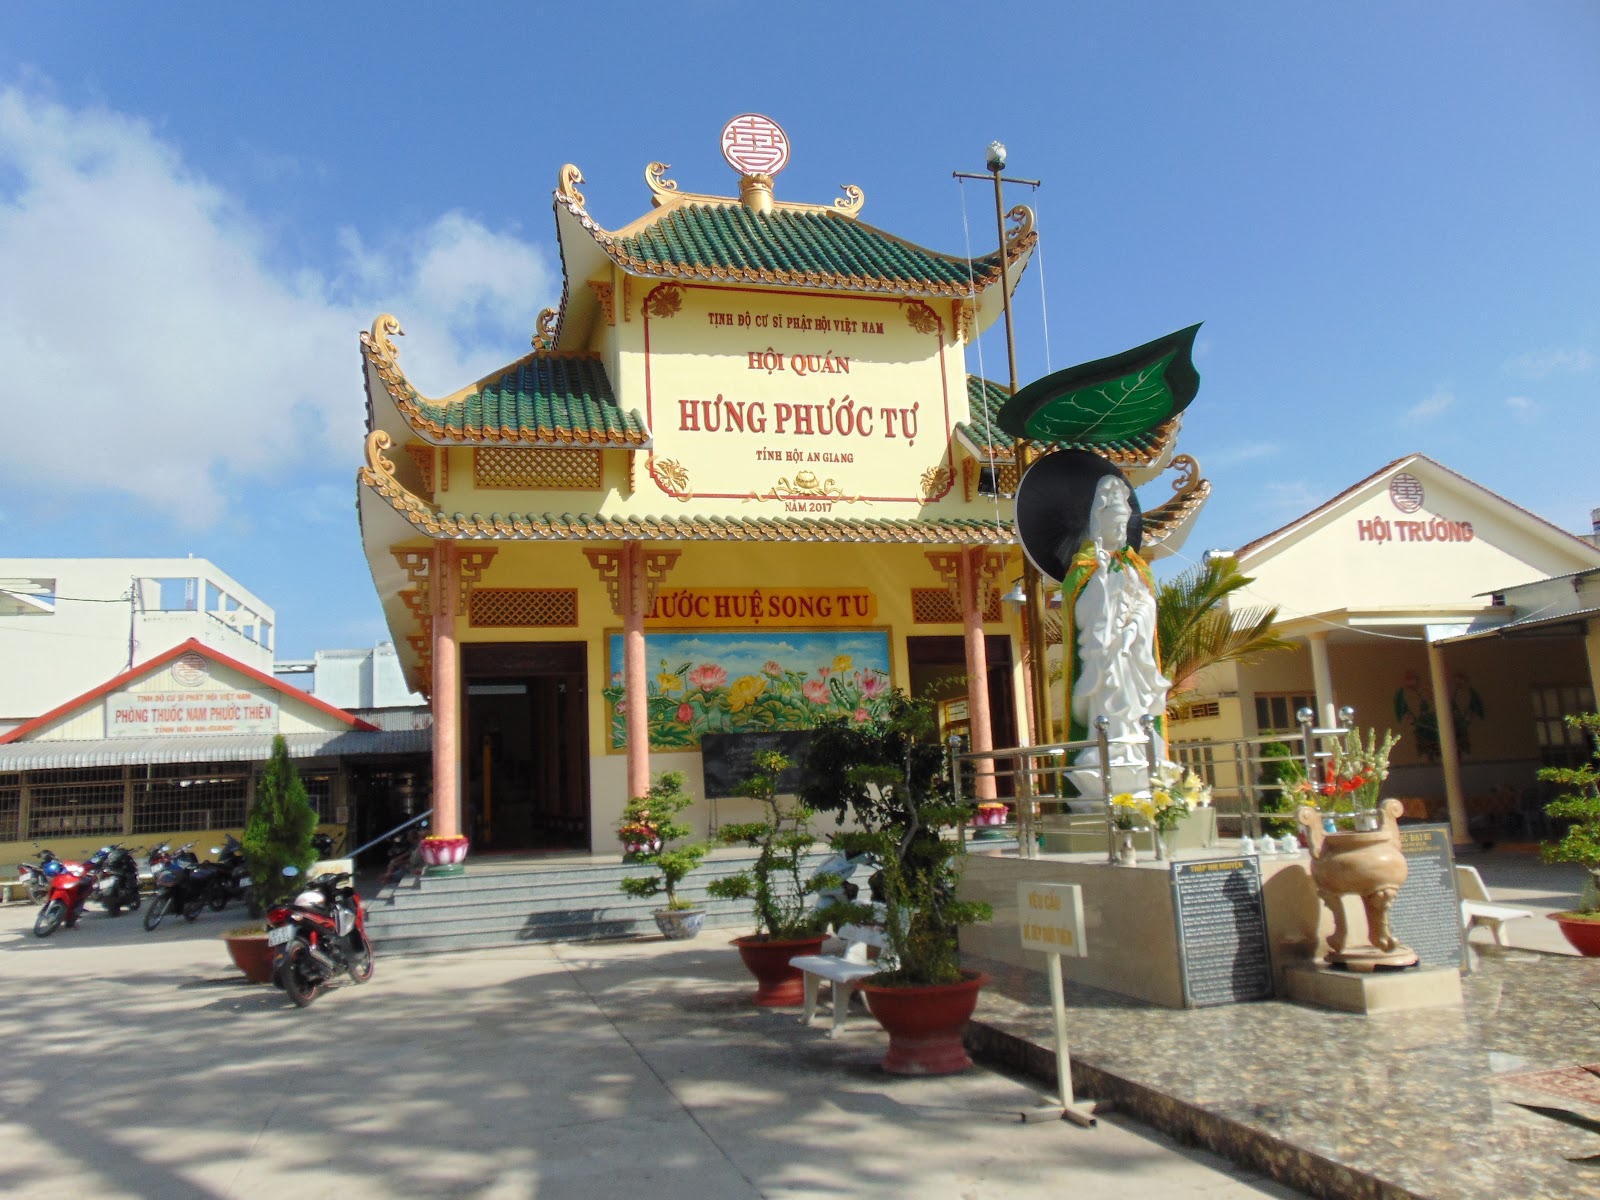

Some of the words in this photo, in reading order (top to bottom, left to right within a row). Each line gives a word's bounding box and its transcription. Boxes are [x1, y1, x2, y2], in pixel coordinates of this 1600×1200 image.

[708, 312, 733, 328] TỊNH
[737, 311, 751, 329] ĐỘ
[755, 313, 769, 327] CƯ
[786, 314, 813, 335] PHẬT
[814, 315, 832, 334] HỘI
[834, 316, 858, 335] VIỆT
[862, 321, 884, 334] NAM
[748, 347, 785, 375] HỘI
[791, 350, 850, 376] QUÁN
[678, 393, 767, 433] HƯNG
[774, 394, 873, 437] PHƯỚC
[881, 401, 919, 447] TỰ
[786, 448, 803, 464] HỘI
[807, 452, 820, 462] AN
[822, 452, 854, 463] GIANG
[809, 502, 833, 512] 2017
[1357, 515, 1392, 545] HỘI
[1394, 513, 1474, 542] TRƯỜNG
[714, 589, 764, 624] HUỆ
[769, 595, 832, 618] SONG
[837, 594, 868, 617] TU
[115, 706, 148, 723] PHÒNG
[151, 703, 183, 722] THUỐC
[186, 707, 207, 721] NAM
[210, 702, 241, 721] PHƯỚC
[244, 704, 271, 720] THIỆN
